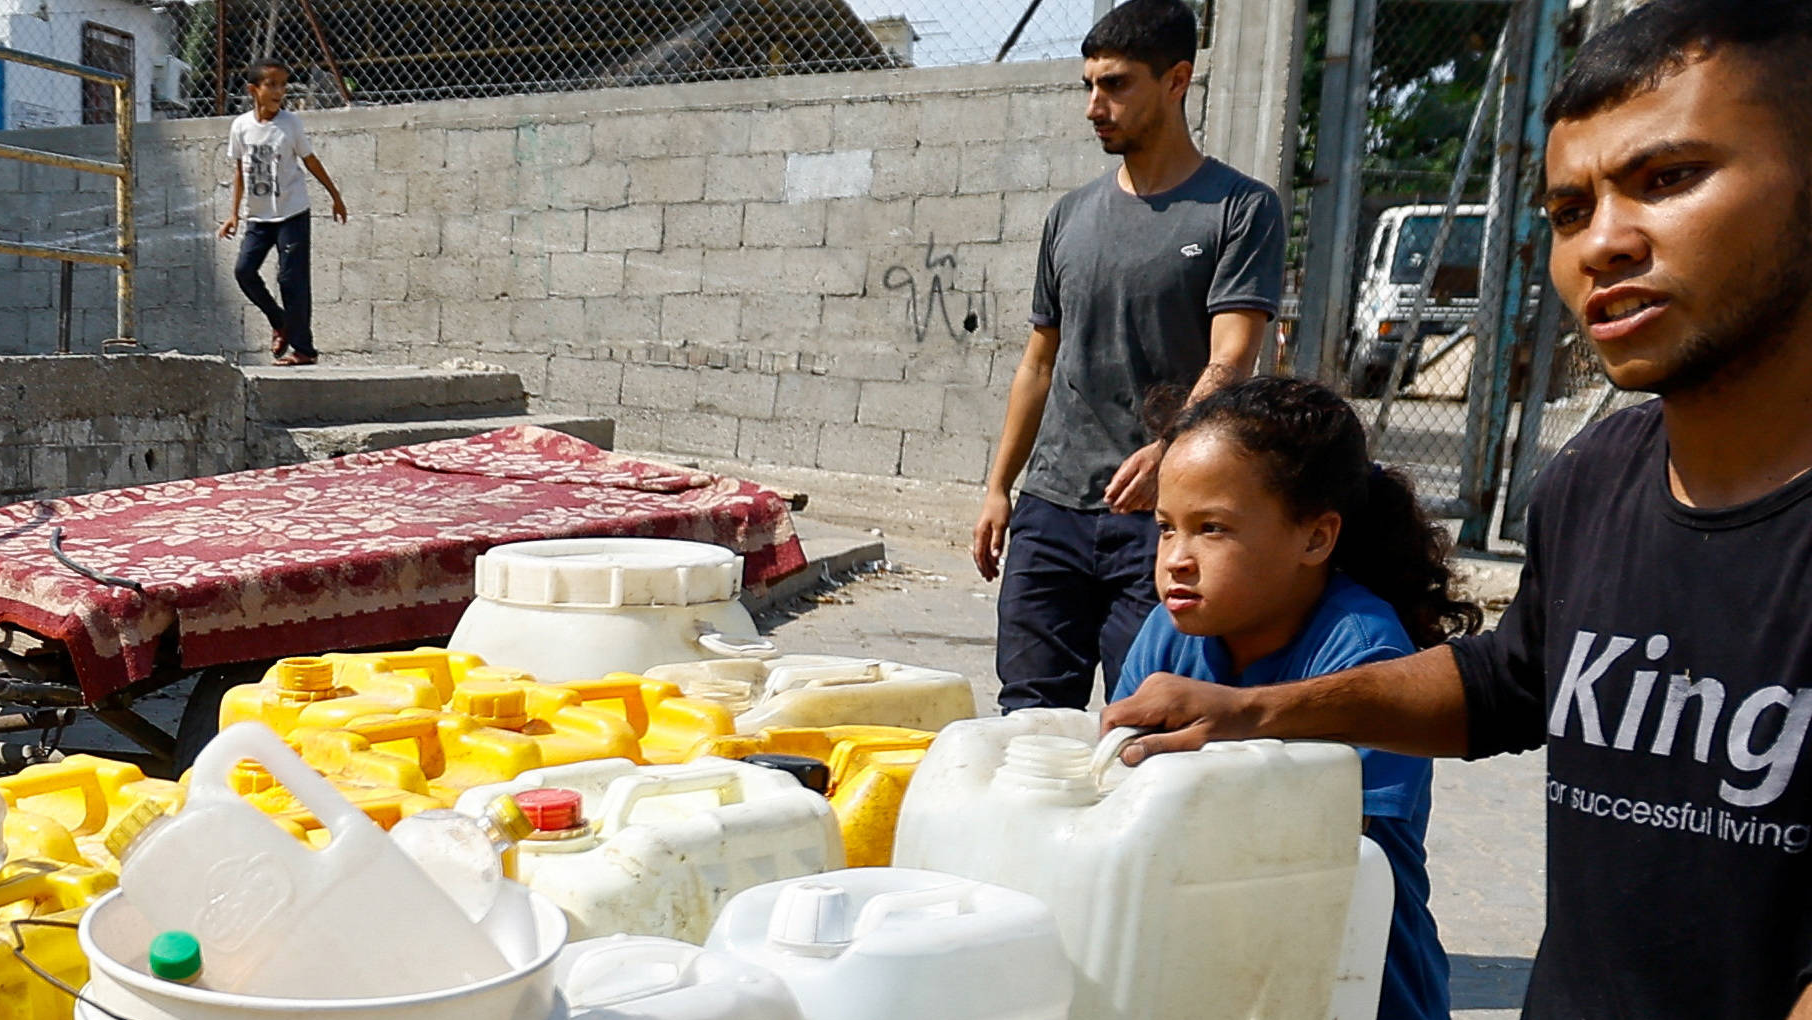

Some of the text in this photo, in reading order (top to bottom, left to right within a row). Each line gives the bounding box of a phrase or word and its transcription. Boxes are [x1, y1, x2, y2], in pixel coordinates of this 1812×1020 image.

[1548, 629, 1812, 808] King
[1547, 772, 1811, 855] or successful living
